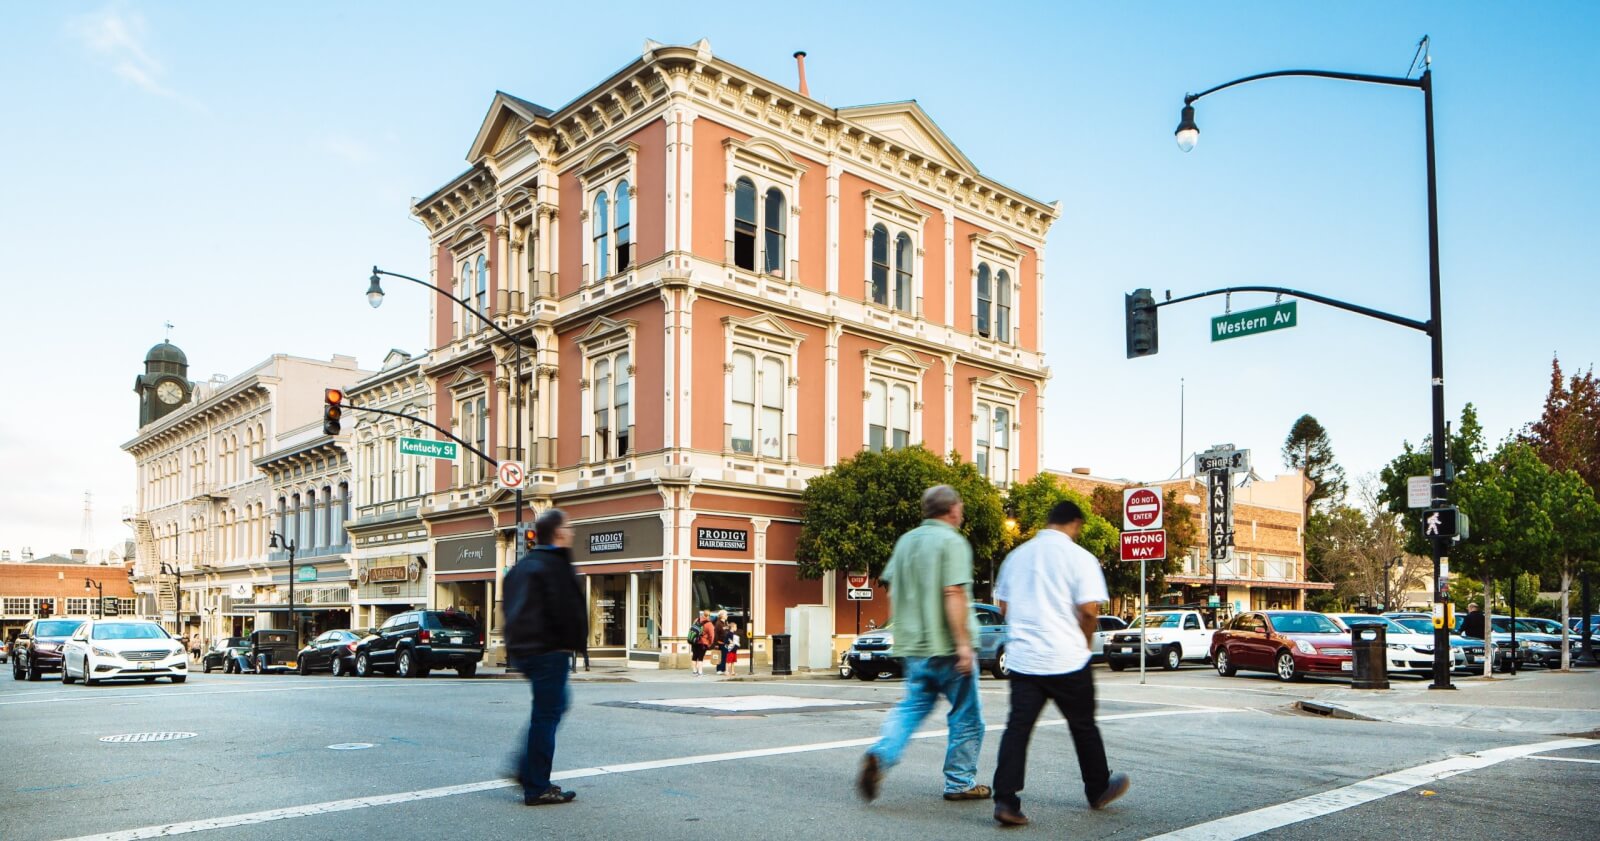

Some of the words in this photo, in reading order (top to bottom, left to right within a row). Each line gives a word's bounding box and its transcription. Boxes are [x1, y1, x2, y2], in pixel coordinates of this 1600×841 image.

[1216, 317, 1267, 335] Western
[1273, 310, 1291, 325] Av
[402, 440, 442, 456] Kentucky
[443, 445, 454, 456] St
[1213, 475, 1225, 509] LAN
[1131, 497, 1140, 505] DO
[1141, 496, 1154, 504] NOT
[1133, 512, 1153, 521] ENTER
[590, 532, 623, 544] PRODIGY
[699, 529, 746, 541] PRODIGY
[1123, 533, 1163, 545] WRONG
[699, 540, 746, 550] HAIRDRESSING
[1131, 546, 1154, 557] WAY
